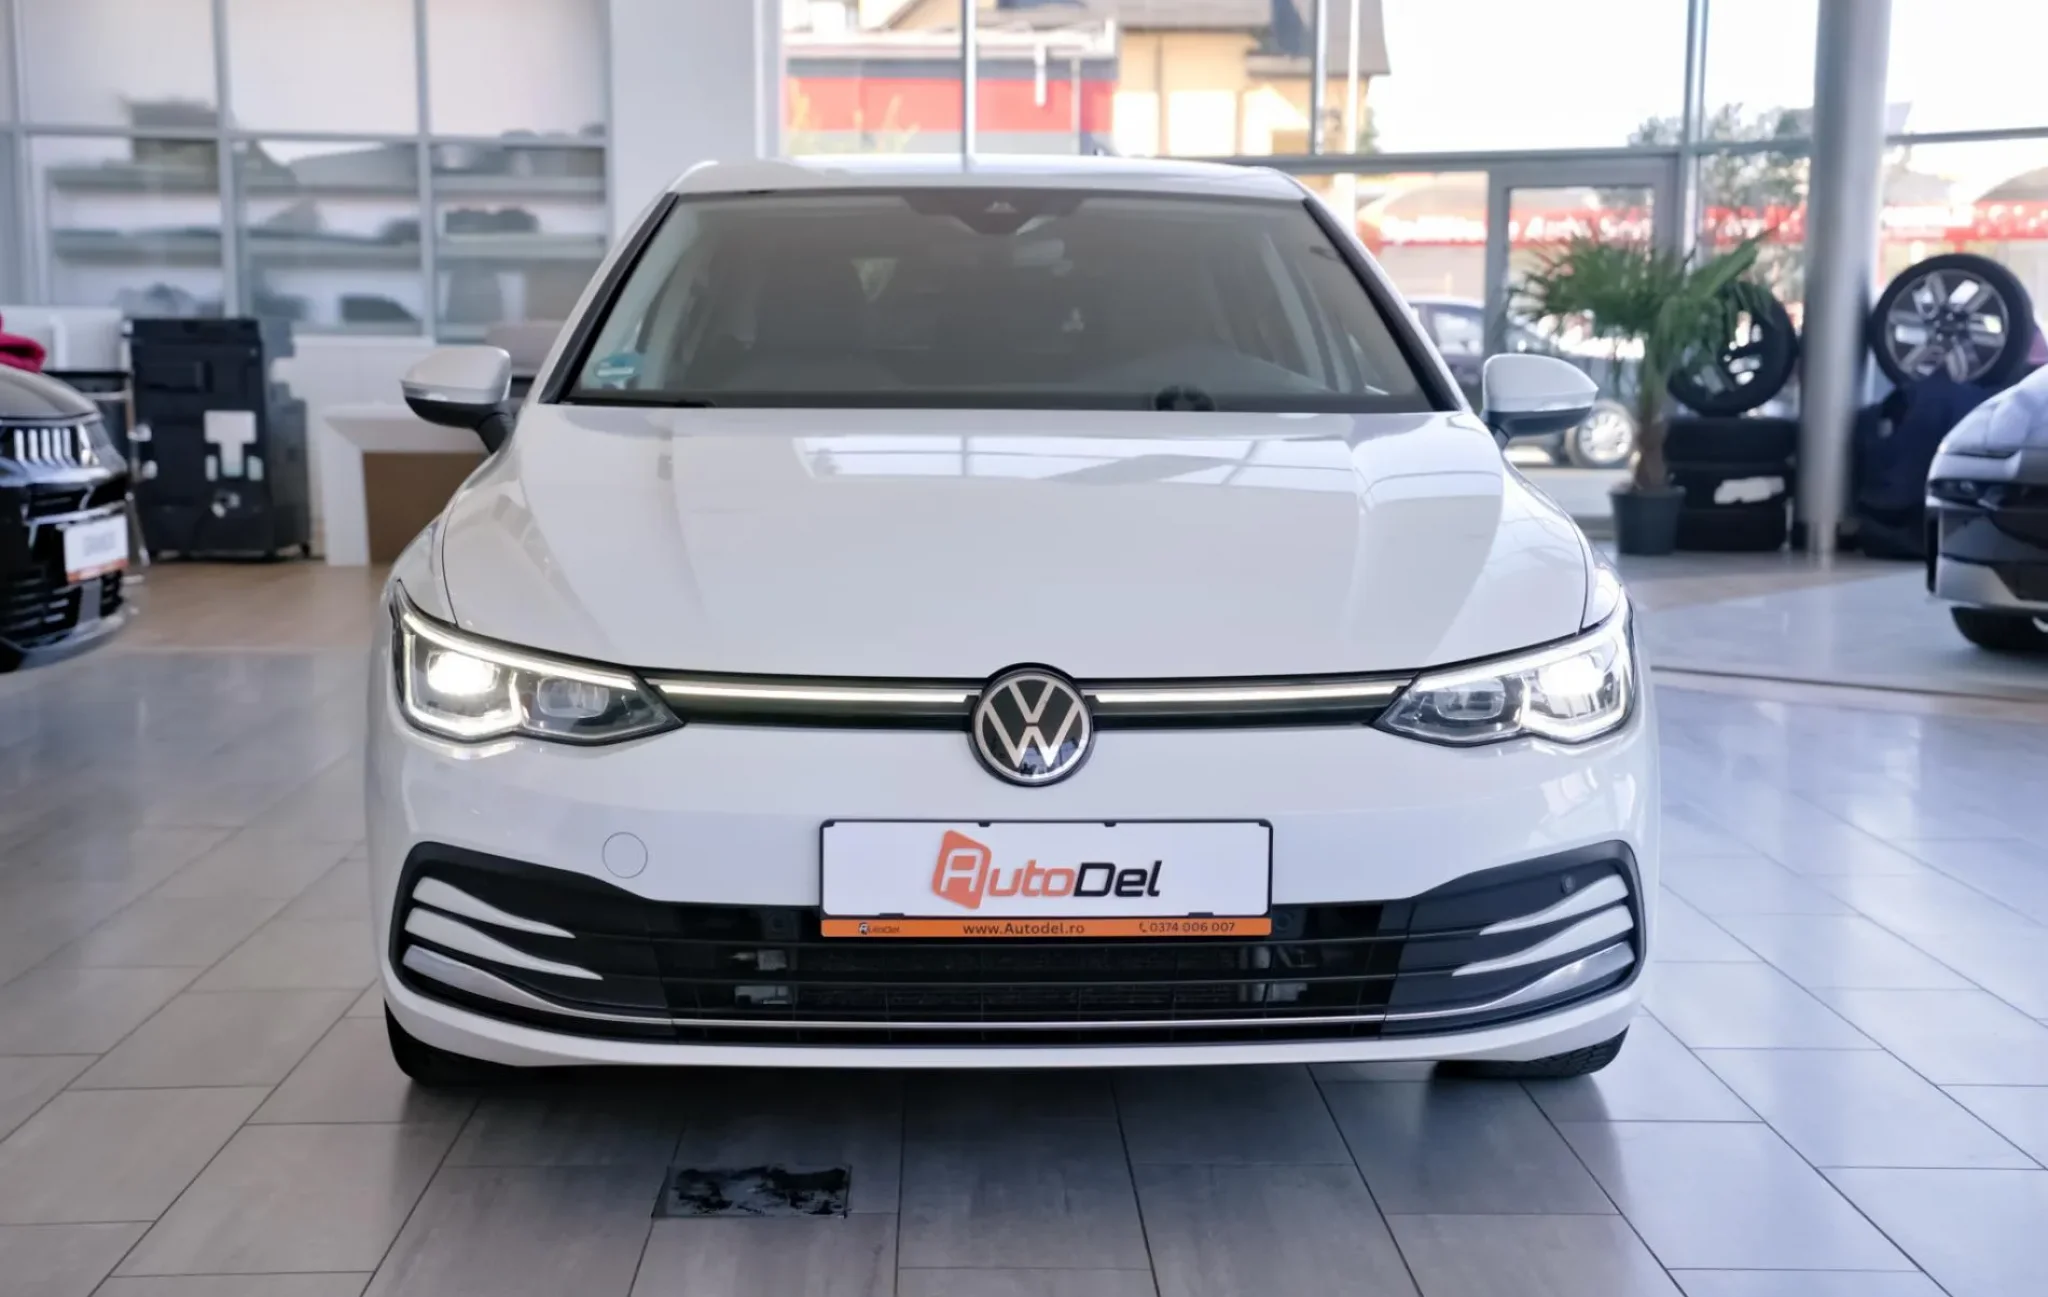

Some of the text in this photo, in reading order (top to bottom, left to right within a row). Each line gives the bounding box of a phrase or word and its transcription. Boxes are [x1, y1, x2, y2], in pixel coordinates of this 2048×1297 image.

[978, 677, 1087, 776] VW
[936, 838, 1163, 902] AutoDel
[962, 921, 1086, 935] www.Autodel.ro
[1149, 922, 1235, 933] 0374 006 007
